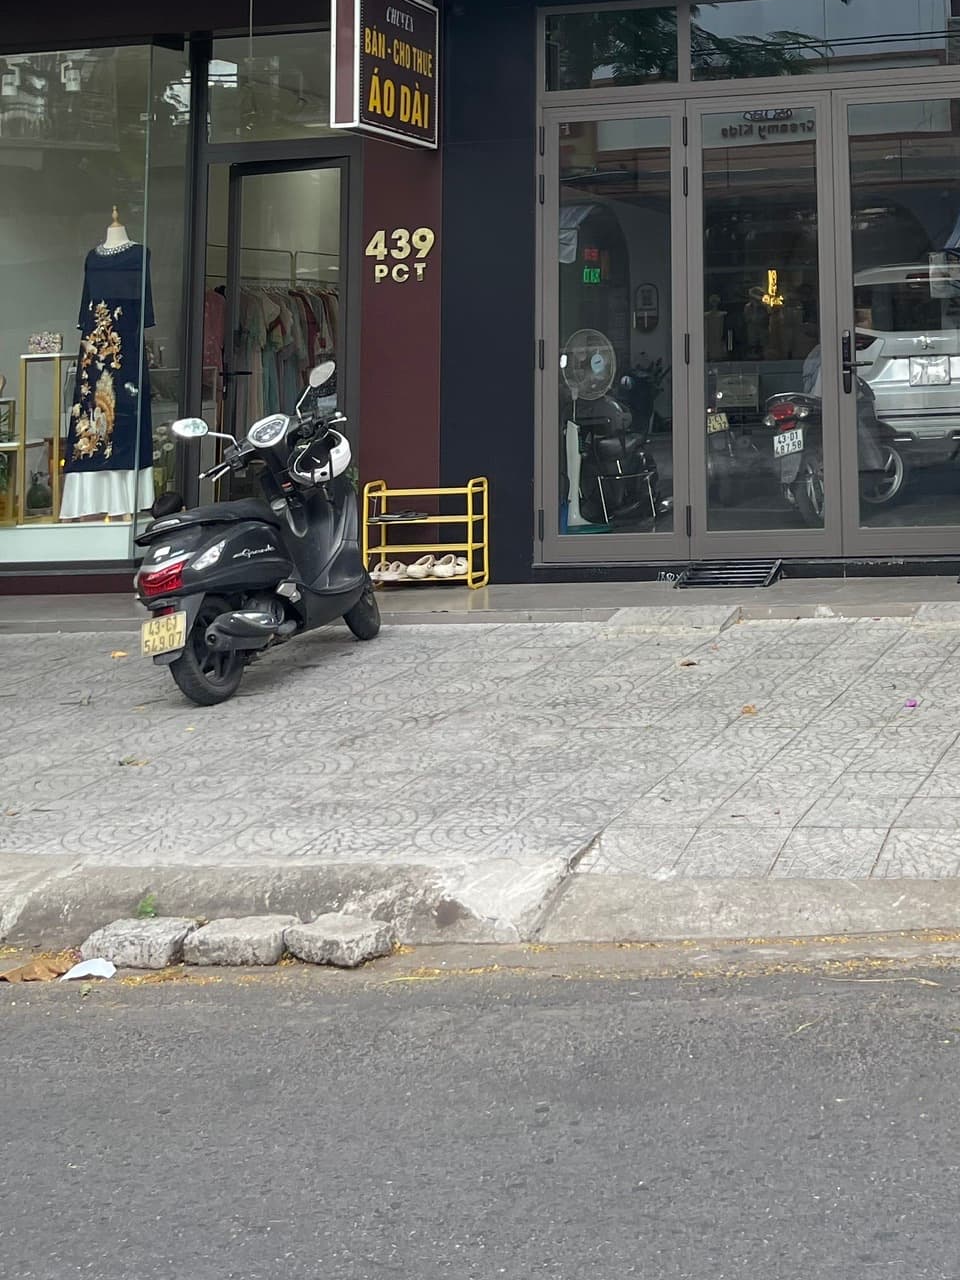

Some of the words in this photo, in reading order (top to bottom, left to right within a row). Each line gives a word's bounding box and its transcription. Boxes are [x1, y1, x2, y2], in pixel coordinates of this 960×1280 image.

[393, 38, 411, 69] CHO
[412, 48, 433, 78] THUÊ
[368, 67, 395, 118] ÁO
[400, 81, 429, 129] DÀI
[365, 227, 435, 261] 439
[374, 262, 427, 284] PCT
